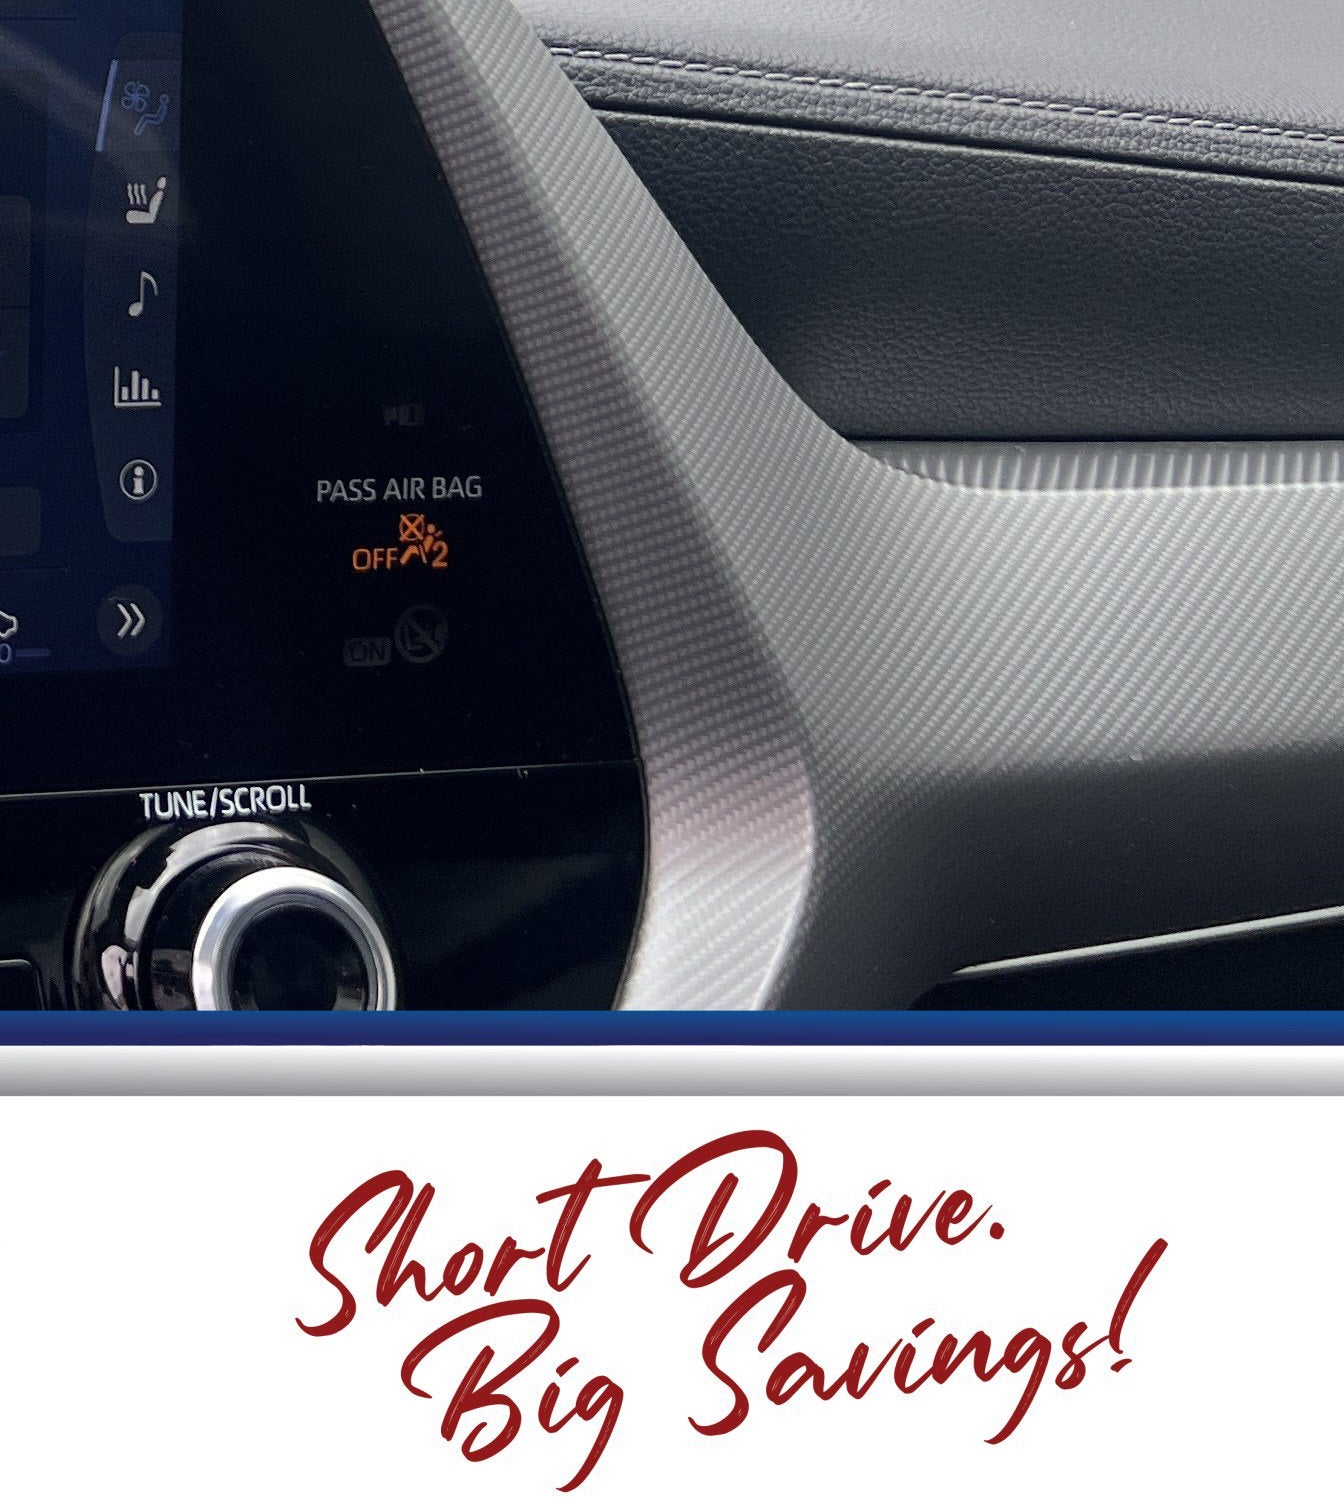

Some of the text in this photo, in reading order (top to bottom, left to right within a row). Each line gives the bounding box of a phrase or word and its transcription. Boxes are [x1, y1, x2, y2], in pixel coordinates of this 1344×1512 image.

[316, 475, 482, 503] PASS AIR BAG
[352, 546, 400, 571] OFF
[138, 781, 313, 821] TUNE/SCROLL
